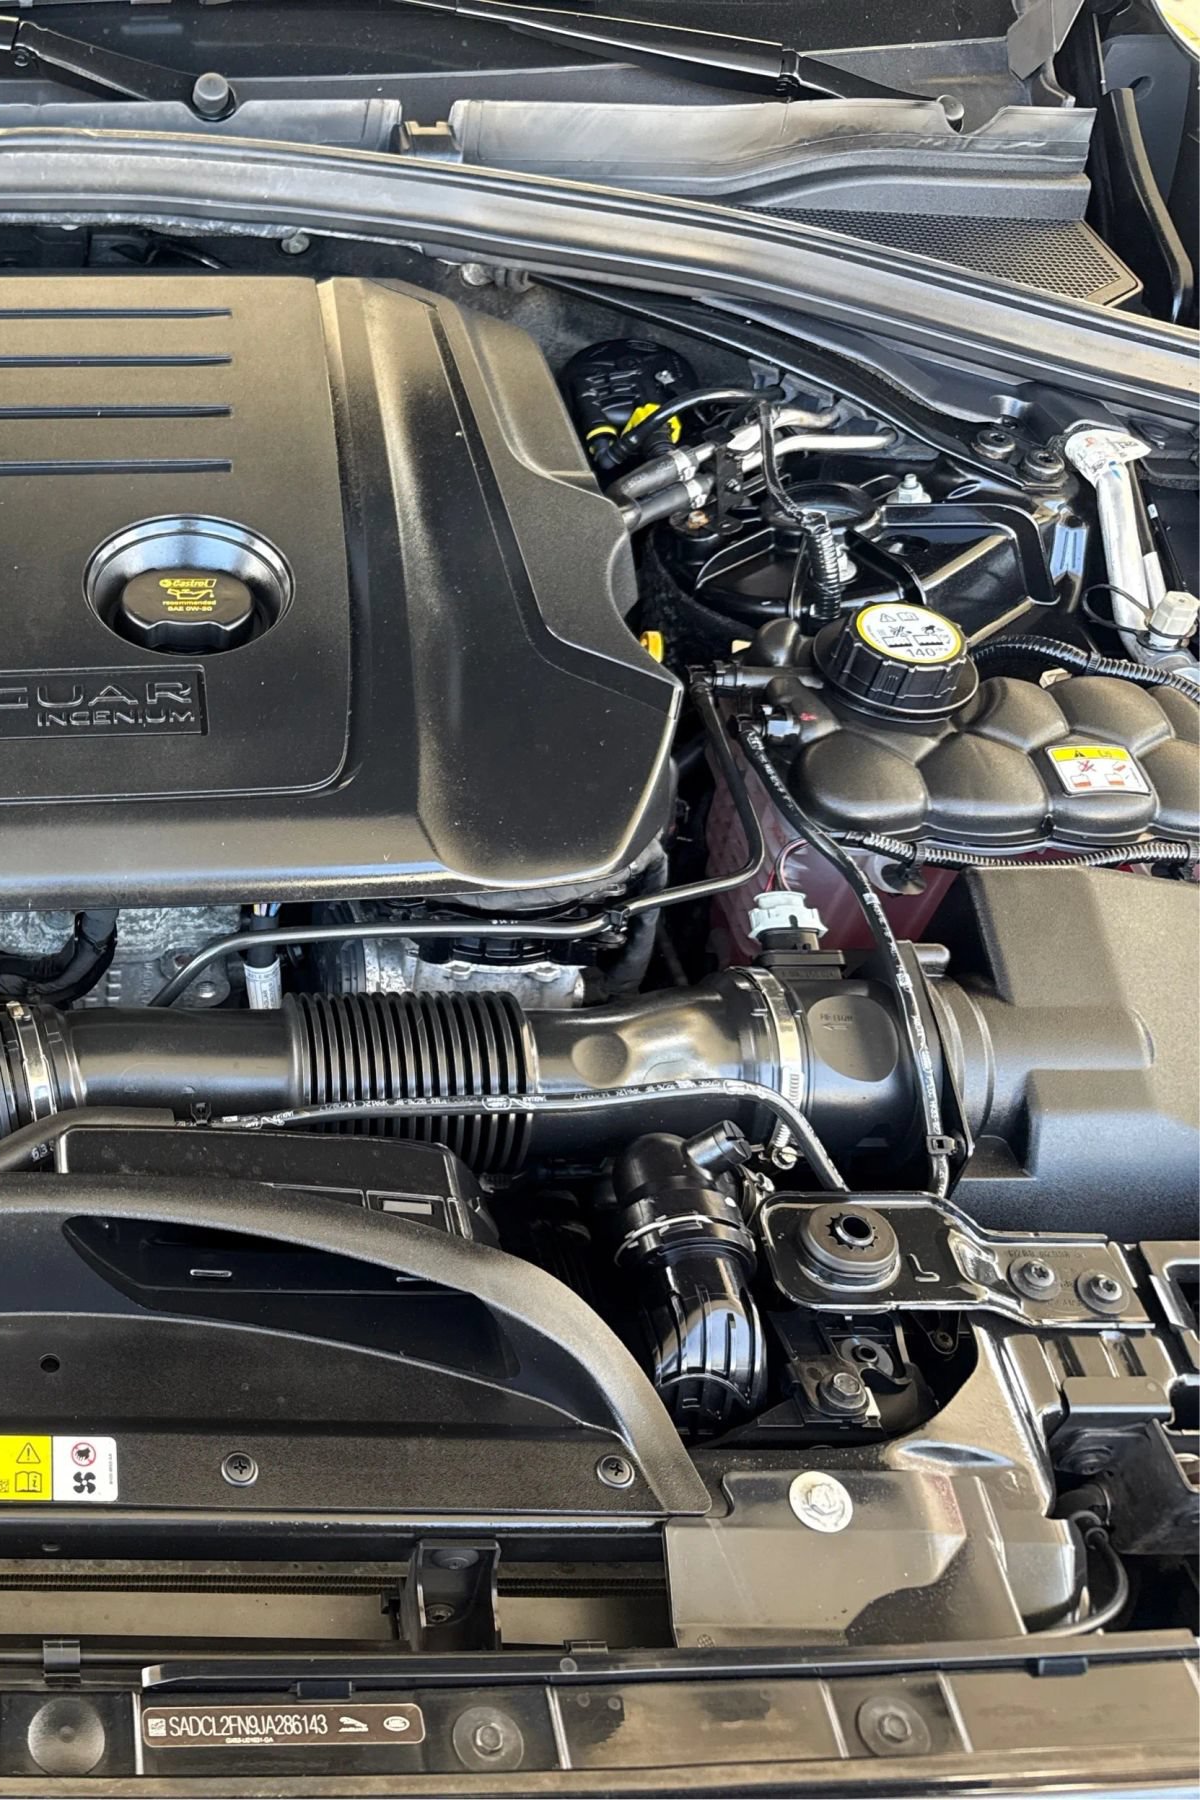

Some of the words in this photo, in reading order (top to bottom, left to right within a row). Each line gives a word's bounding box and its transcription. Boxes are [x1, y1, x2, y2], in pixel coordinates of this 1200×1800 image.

[906, 648, 937, 658] 140
[36, 708, 196, 728] INGENIUM
[168, 1713, 329, 1737] SADCL2FN9JA286143
